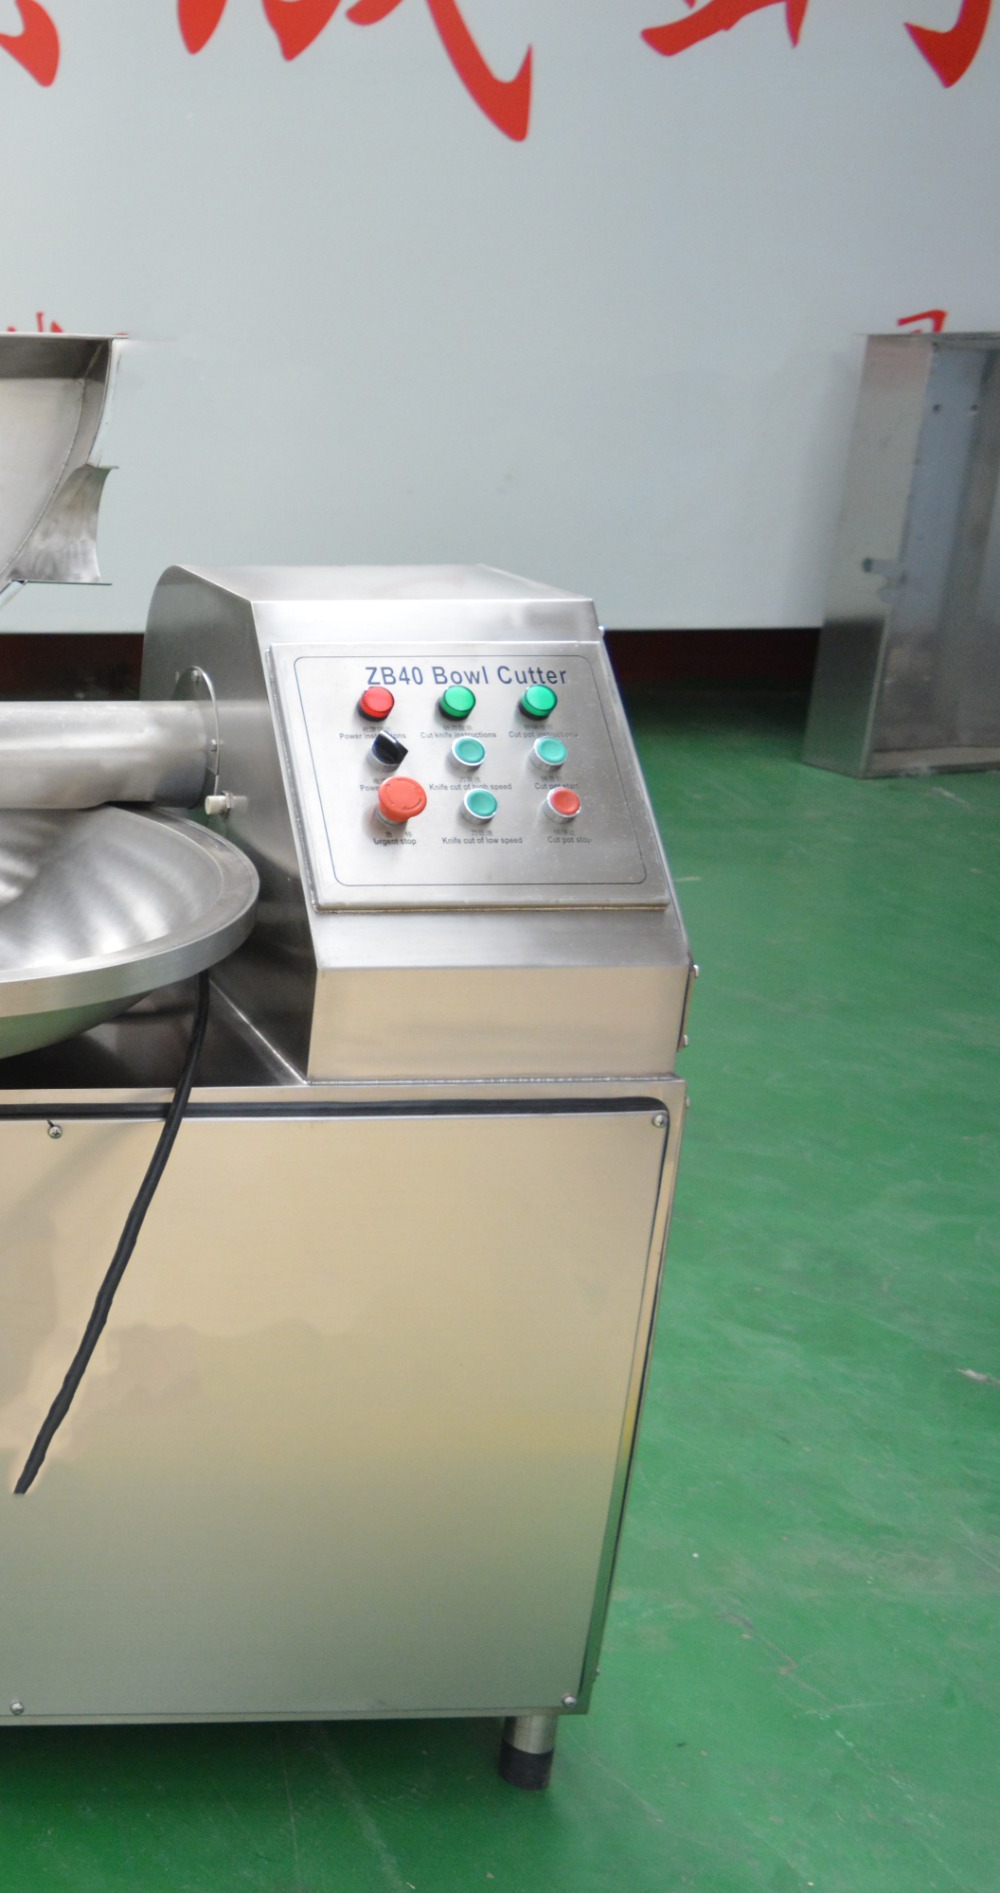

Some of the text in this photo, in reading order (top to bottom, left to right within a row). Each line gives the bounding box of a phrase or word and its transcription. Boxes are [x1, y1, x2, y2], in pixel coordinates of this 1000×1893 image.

[365, 665, 567, 685] ZB40 Bowl Cutter
[339, 732, 362, 740] Power
[420, 731, 433, 739] Cut
[429, 783, 448, 791] Knife
[450, 783, 462, 791] cut
[490, 783, 513, 791] speed
[400, 838, 416, 846] stop
[442, 836, 461, 844] Knife
[485, 836, 499, 844] low
[500, 837, 523, 845] speed
[547, 836, 560, 844] Cut
